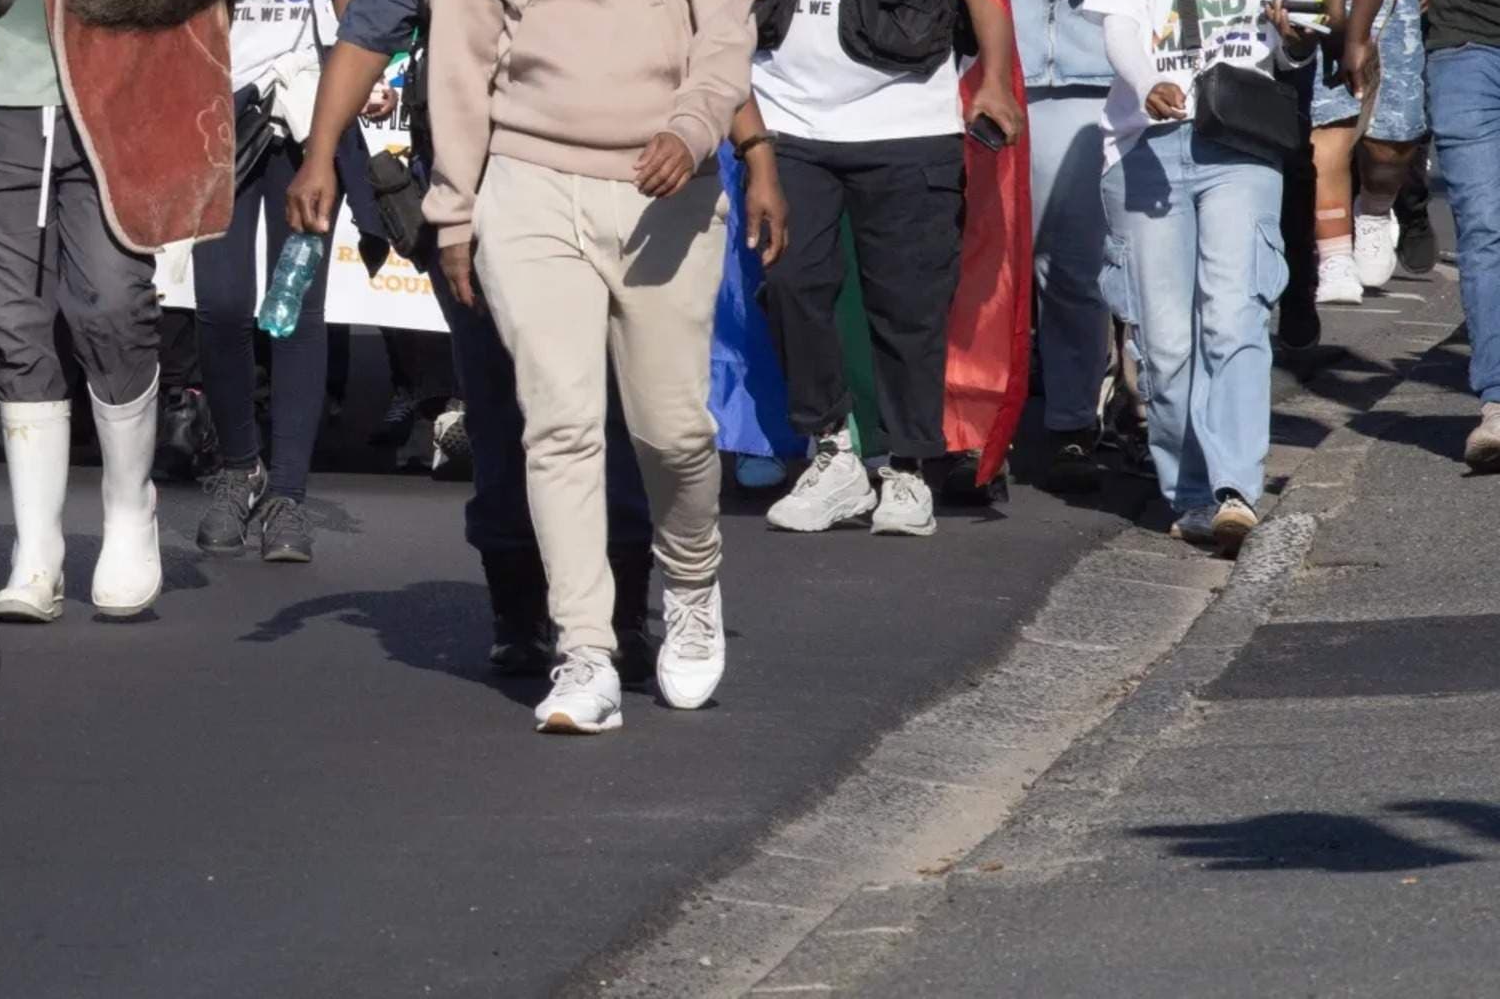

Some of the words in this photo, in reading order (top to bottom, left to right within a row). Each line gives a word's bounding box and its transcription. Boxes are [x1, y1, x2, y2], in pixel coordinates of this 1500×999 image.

[233, 6, 255, 21] TIL
[261, 7, 284, 22] WE
[809, 1, 832, 16] WE
[1223, 44, 1252, 58] WIN
